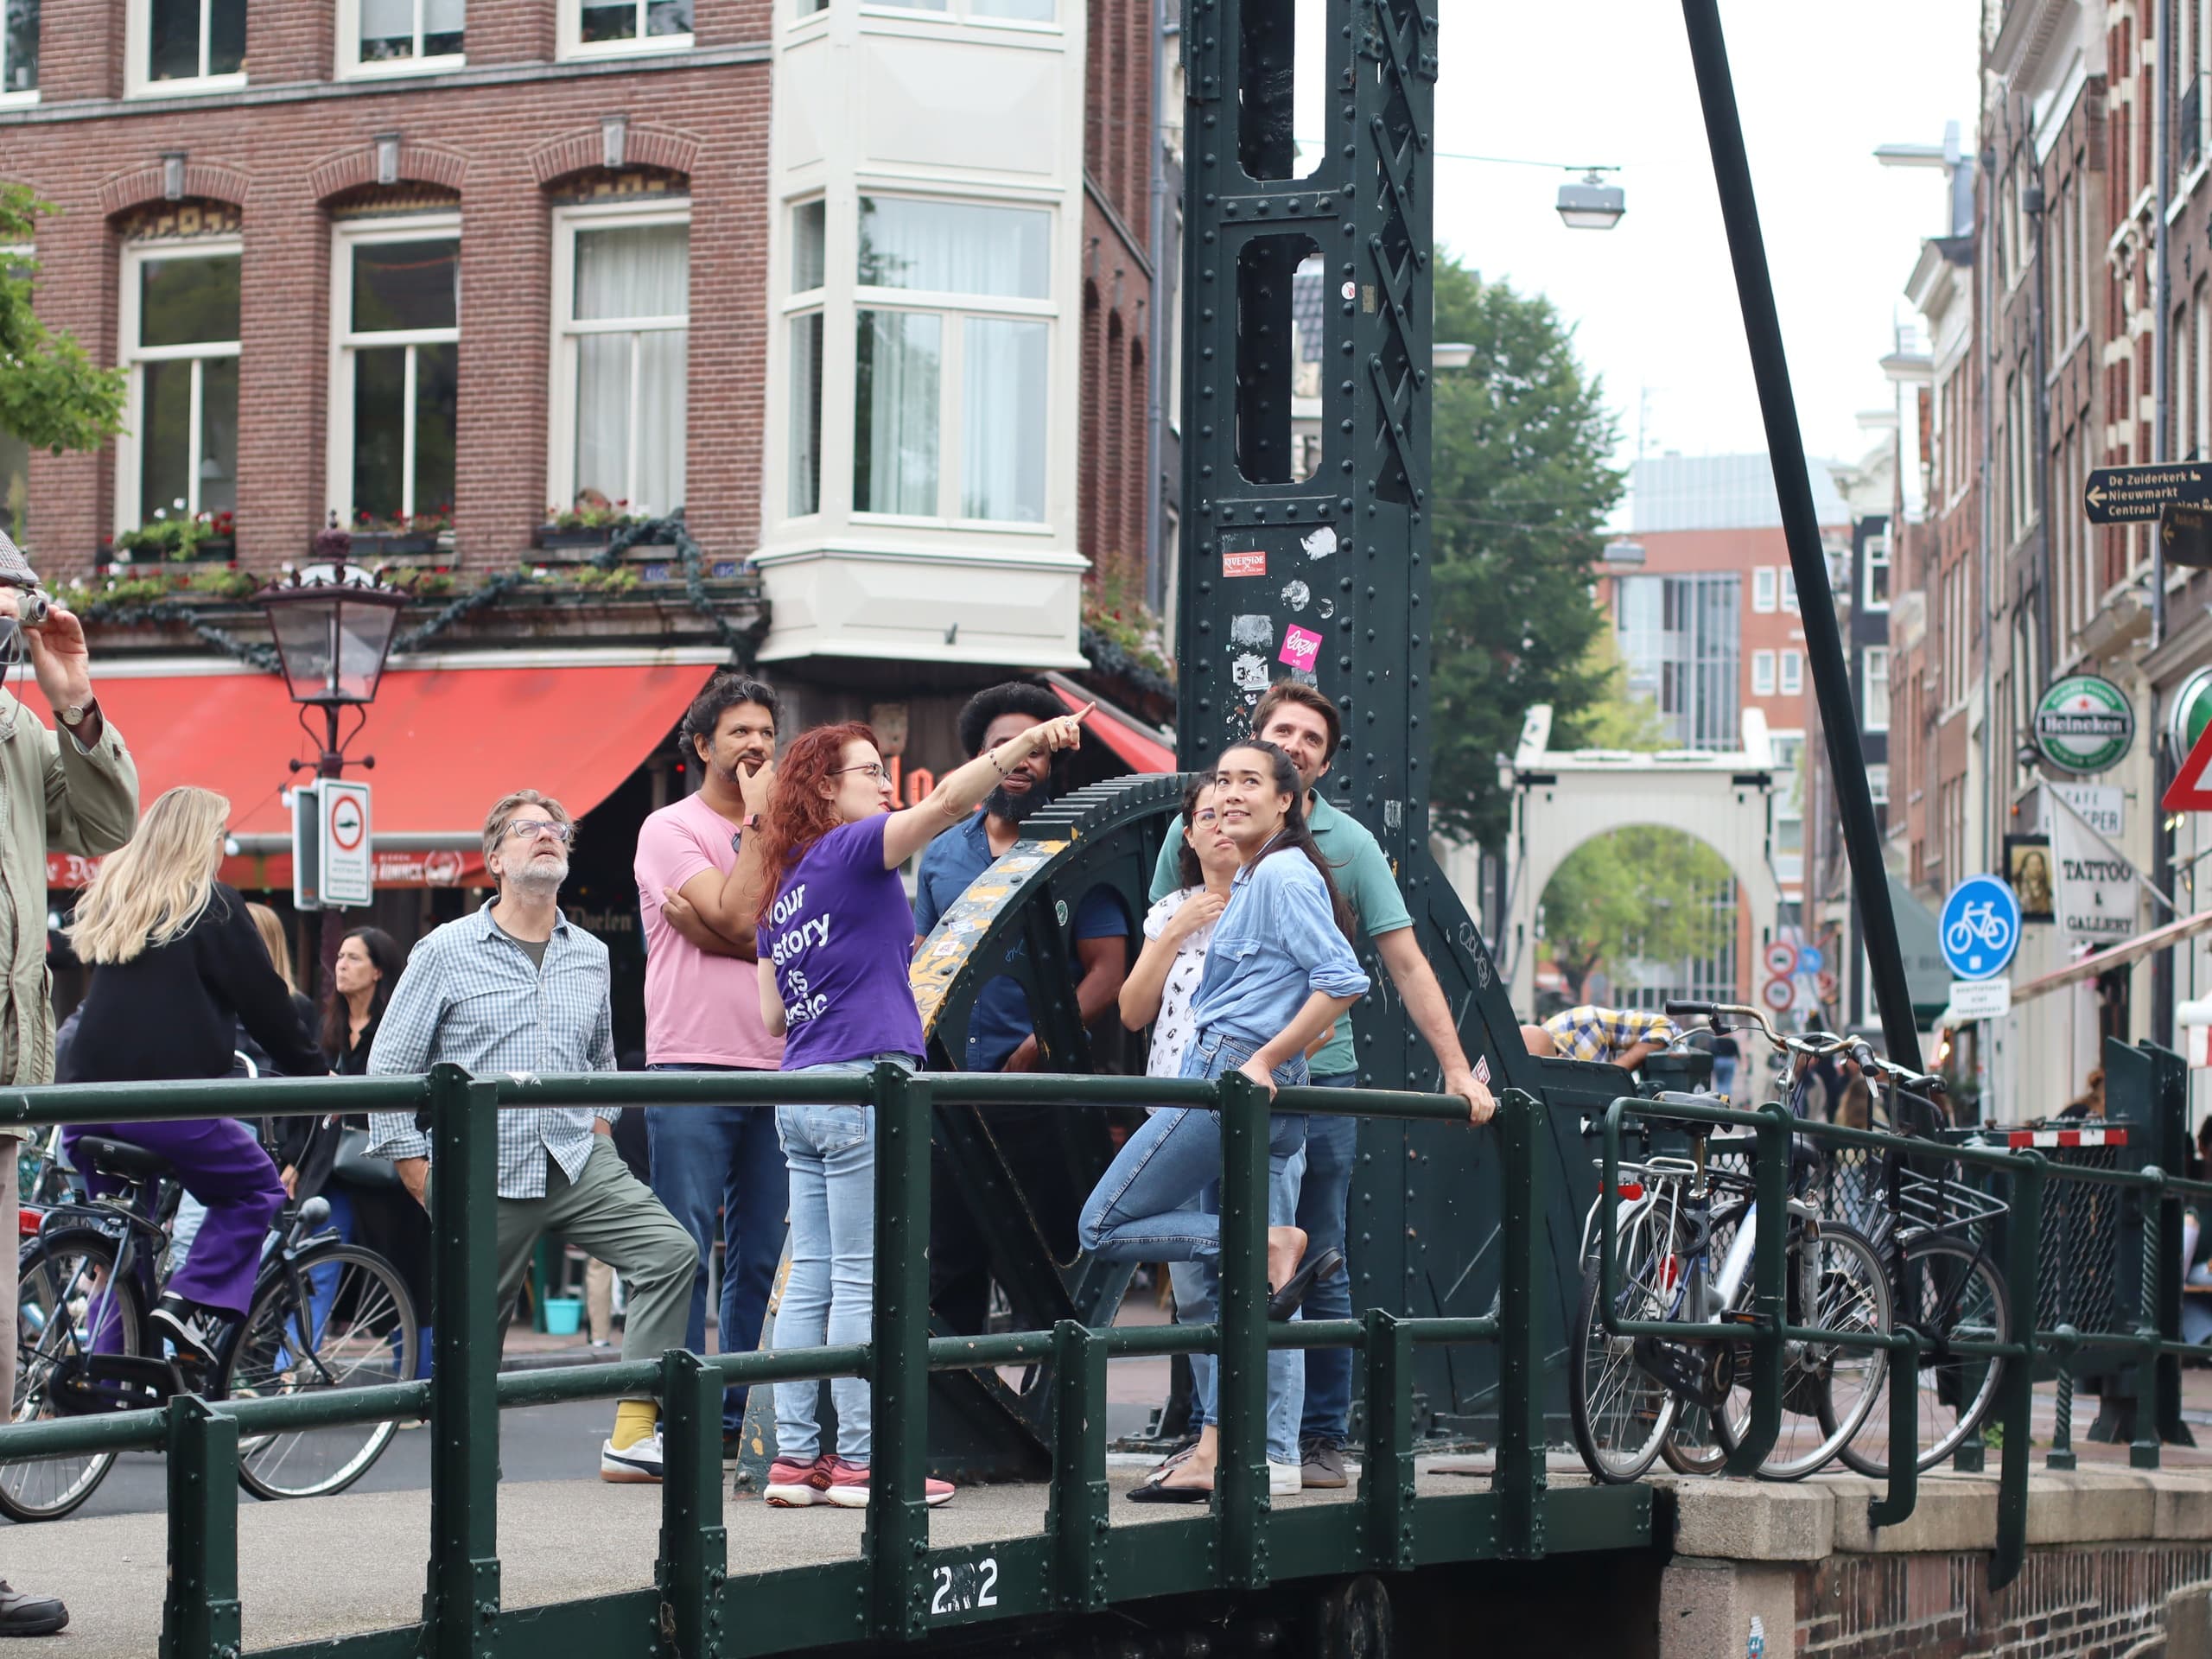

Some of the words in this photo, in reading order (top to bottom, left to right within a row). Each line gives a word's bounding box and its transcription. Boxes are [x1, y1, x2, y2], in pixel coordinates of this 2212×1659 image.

[2109, 475, 2123, 486] De
[2127, 471, 2187, 486] Zuiderkerk
[2108, 487, 2177, 501] Nieuwmarkt
[2108, 503, 2156, 516] Centraal
[2044, 716, 2123, 732] Heineken
[2063, 861, 2132, 881] TATTOO
[2067, 916, 2133, 934] GALLERY
[788, 969, 809, 996] is
